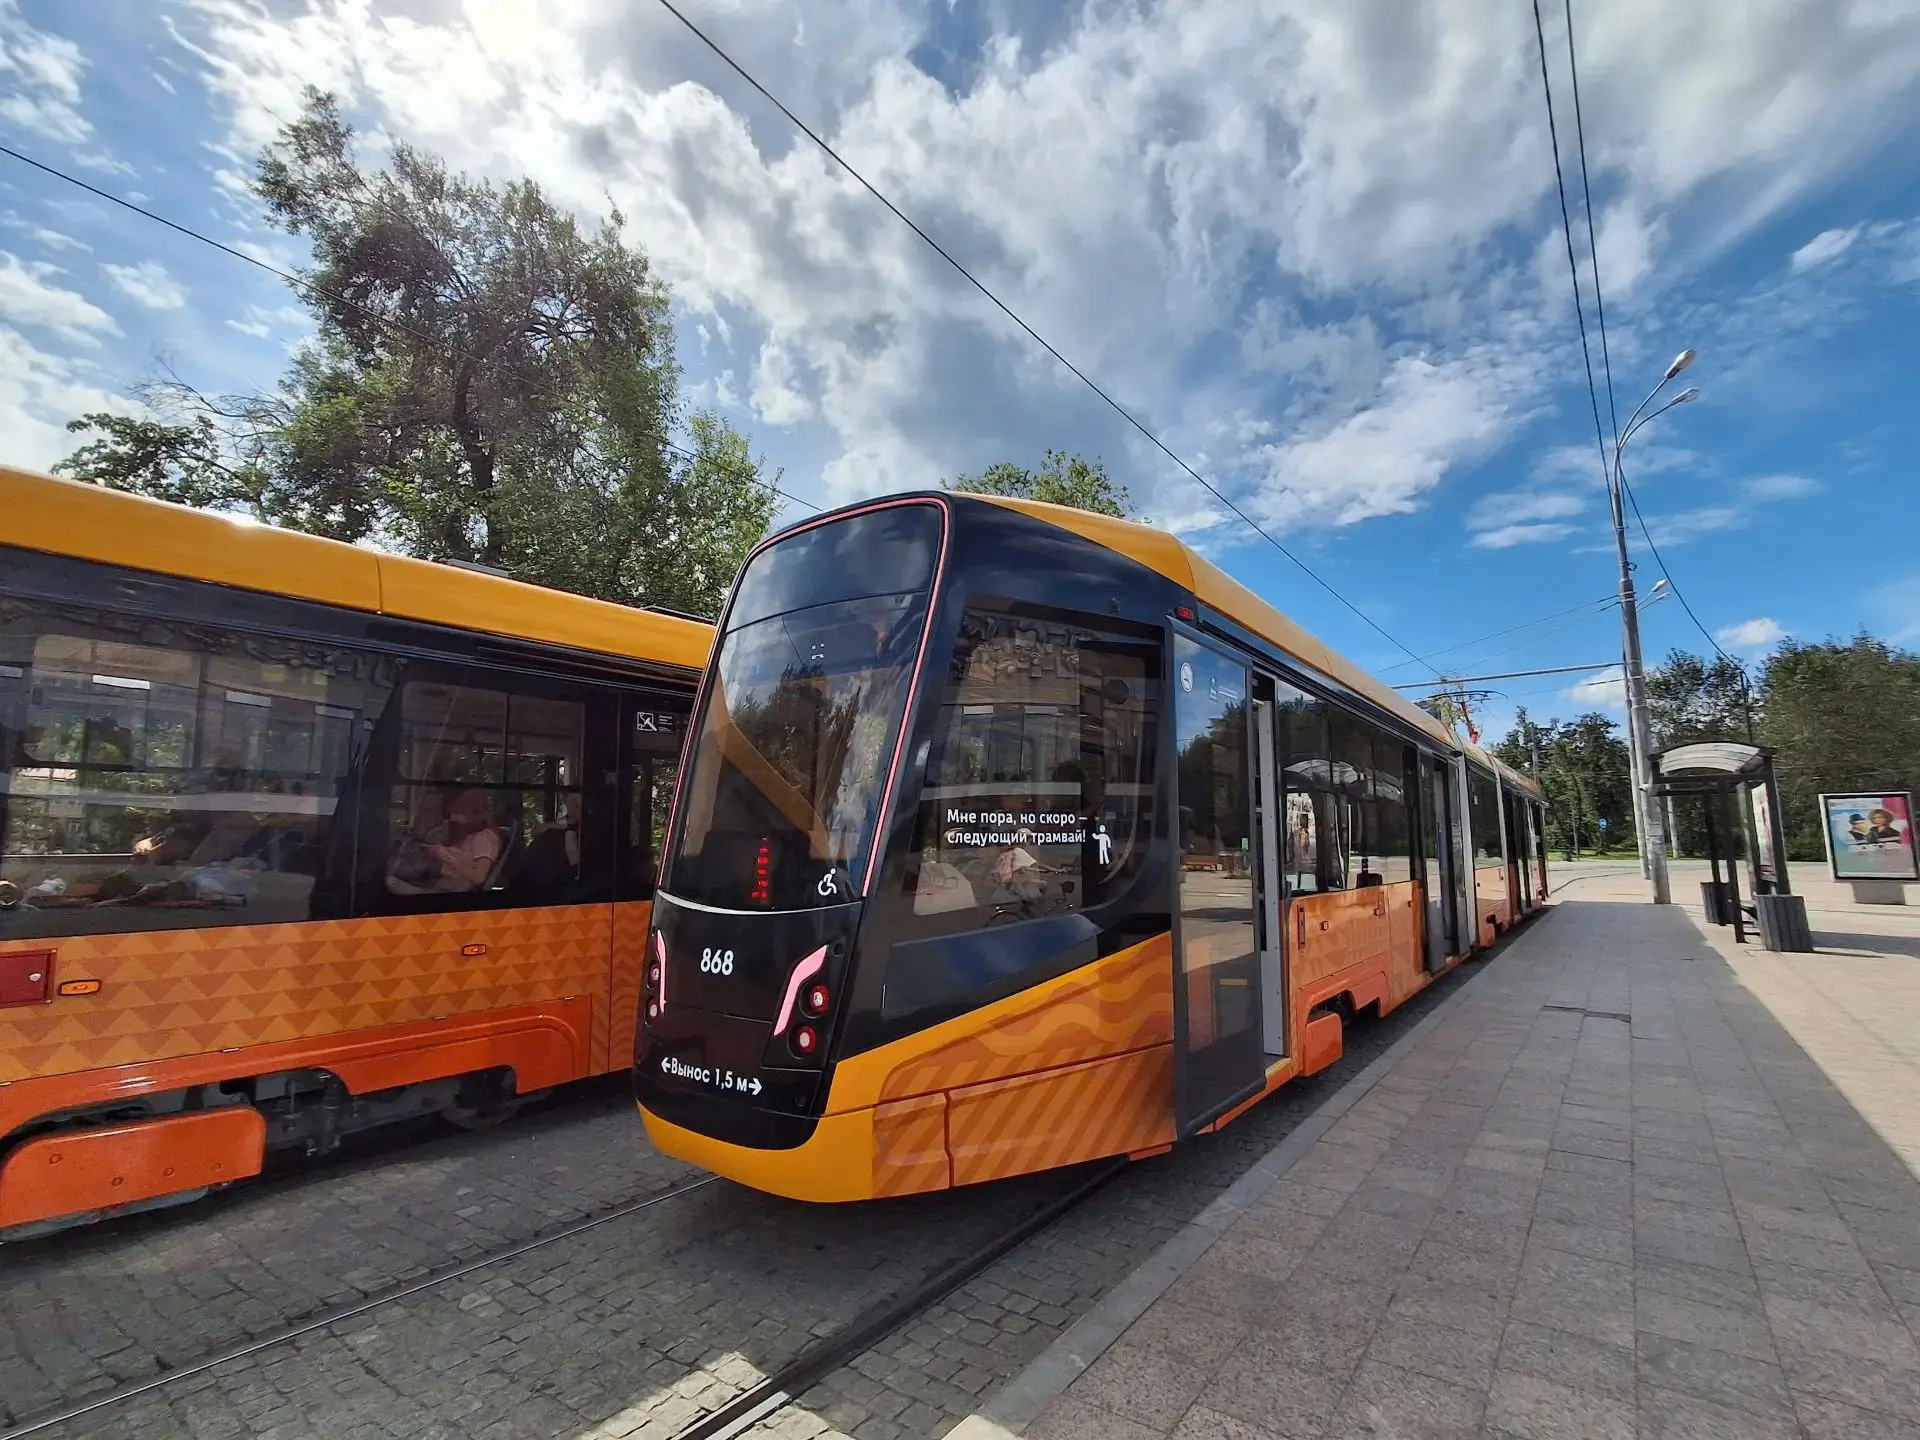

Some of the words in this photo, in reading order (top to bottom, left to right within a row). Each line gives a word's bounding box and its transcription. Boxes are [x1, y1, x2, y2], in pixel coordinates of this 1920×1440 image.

[947, 808, 977, 824] Мне
[980, 811, 1017, 826] пора,
[1020, 812, 1036, 824] но
[1039, 812, 1076, 827] скоро
[947, 829, 1027, 847] следующий
[1030, 829, 1086, 846] трамвай!
[700, 947, 734, 976] 868
[671, 1057, 710, 1083] Вынос
[715, 1068, 733, 1090] 1,5
[736, 1077, 748, 1092] м
